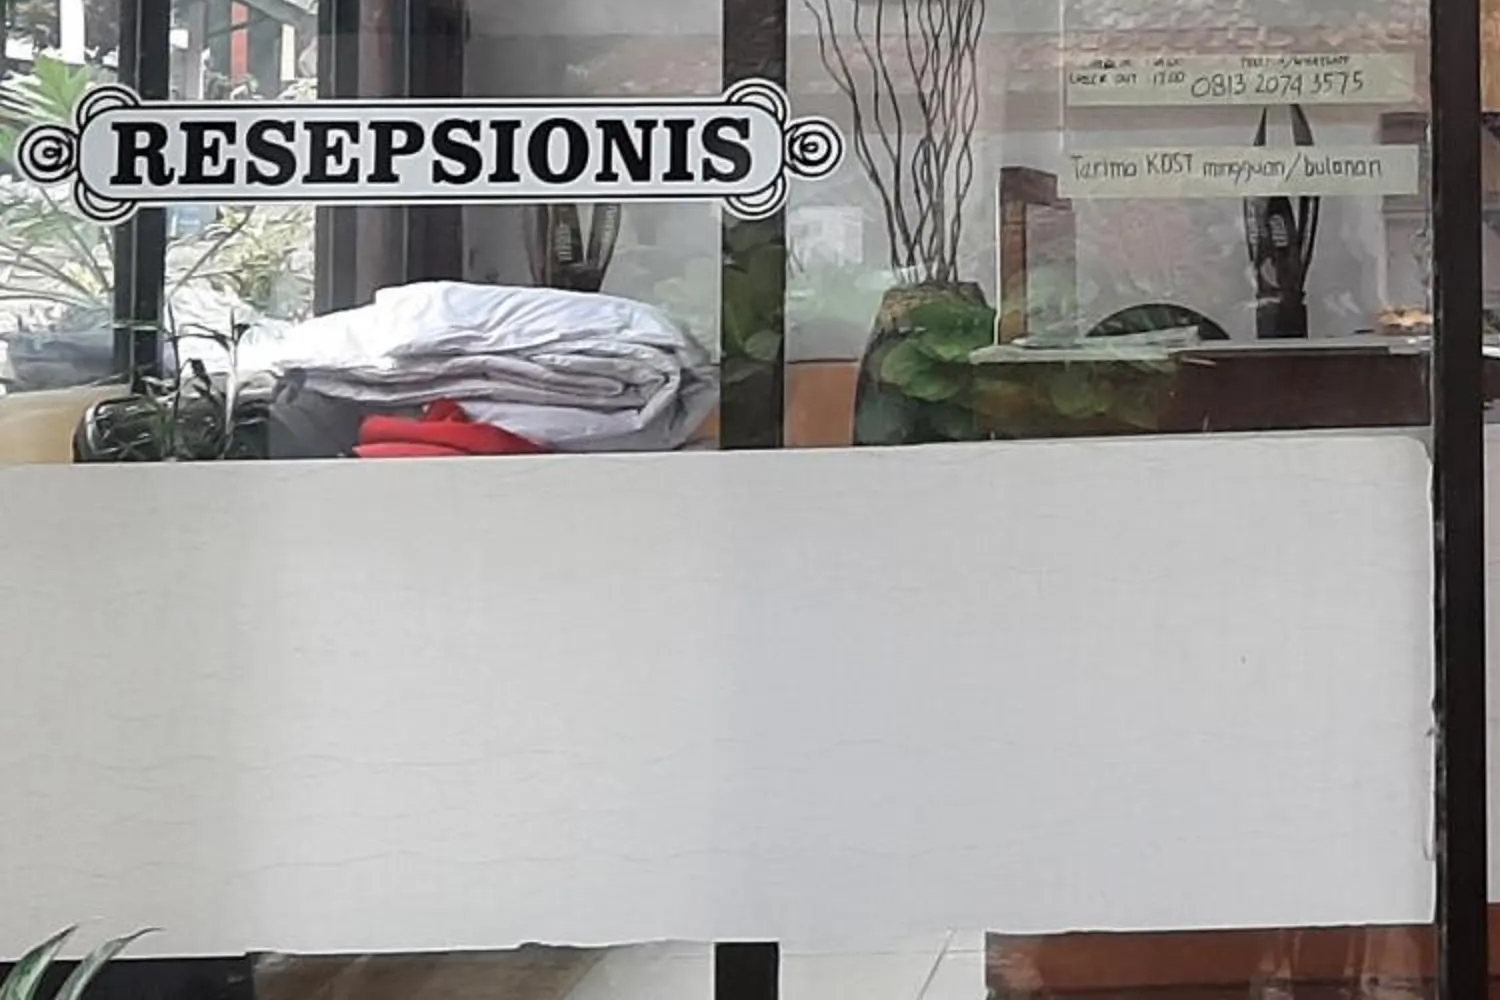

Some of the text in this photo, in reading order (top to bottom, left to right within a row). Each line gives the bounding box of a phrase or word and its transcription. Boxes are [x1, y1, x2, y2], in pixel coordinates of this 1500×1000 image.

[1190, 69, 1364, 98] 0813 2074 3575
[108, 116, 753, 187] RESEPSIONIS
[1145, 152, 1194, 176] KOST
